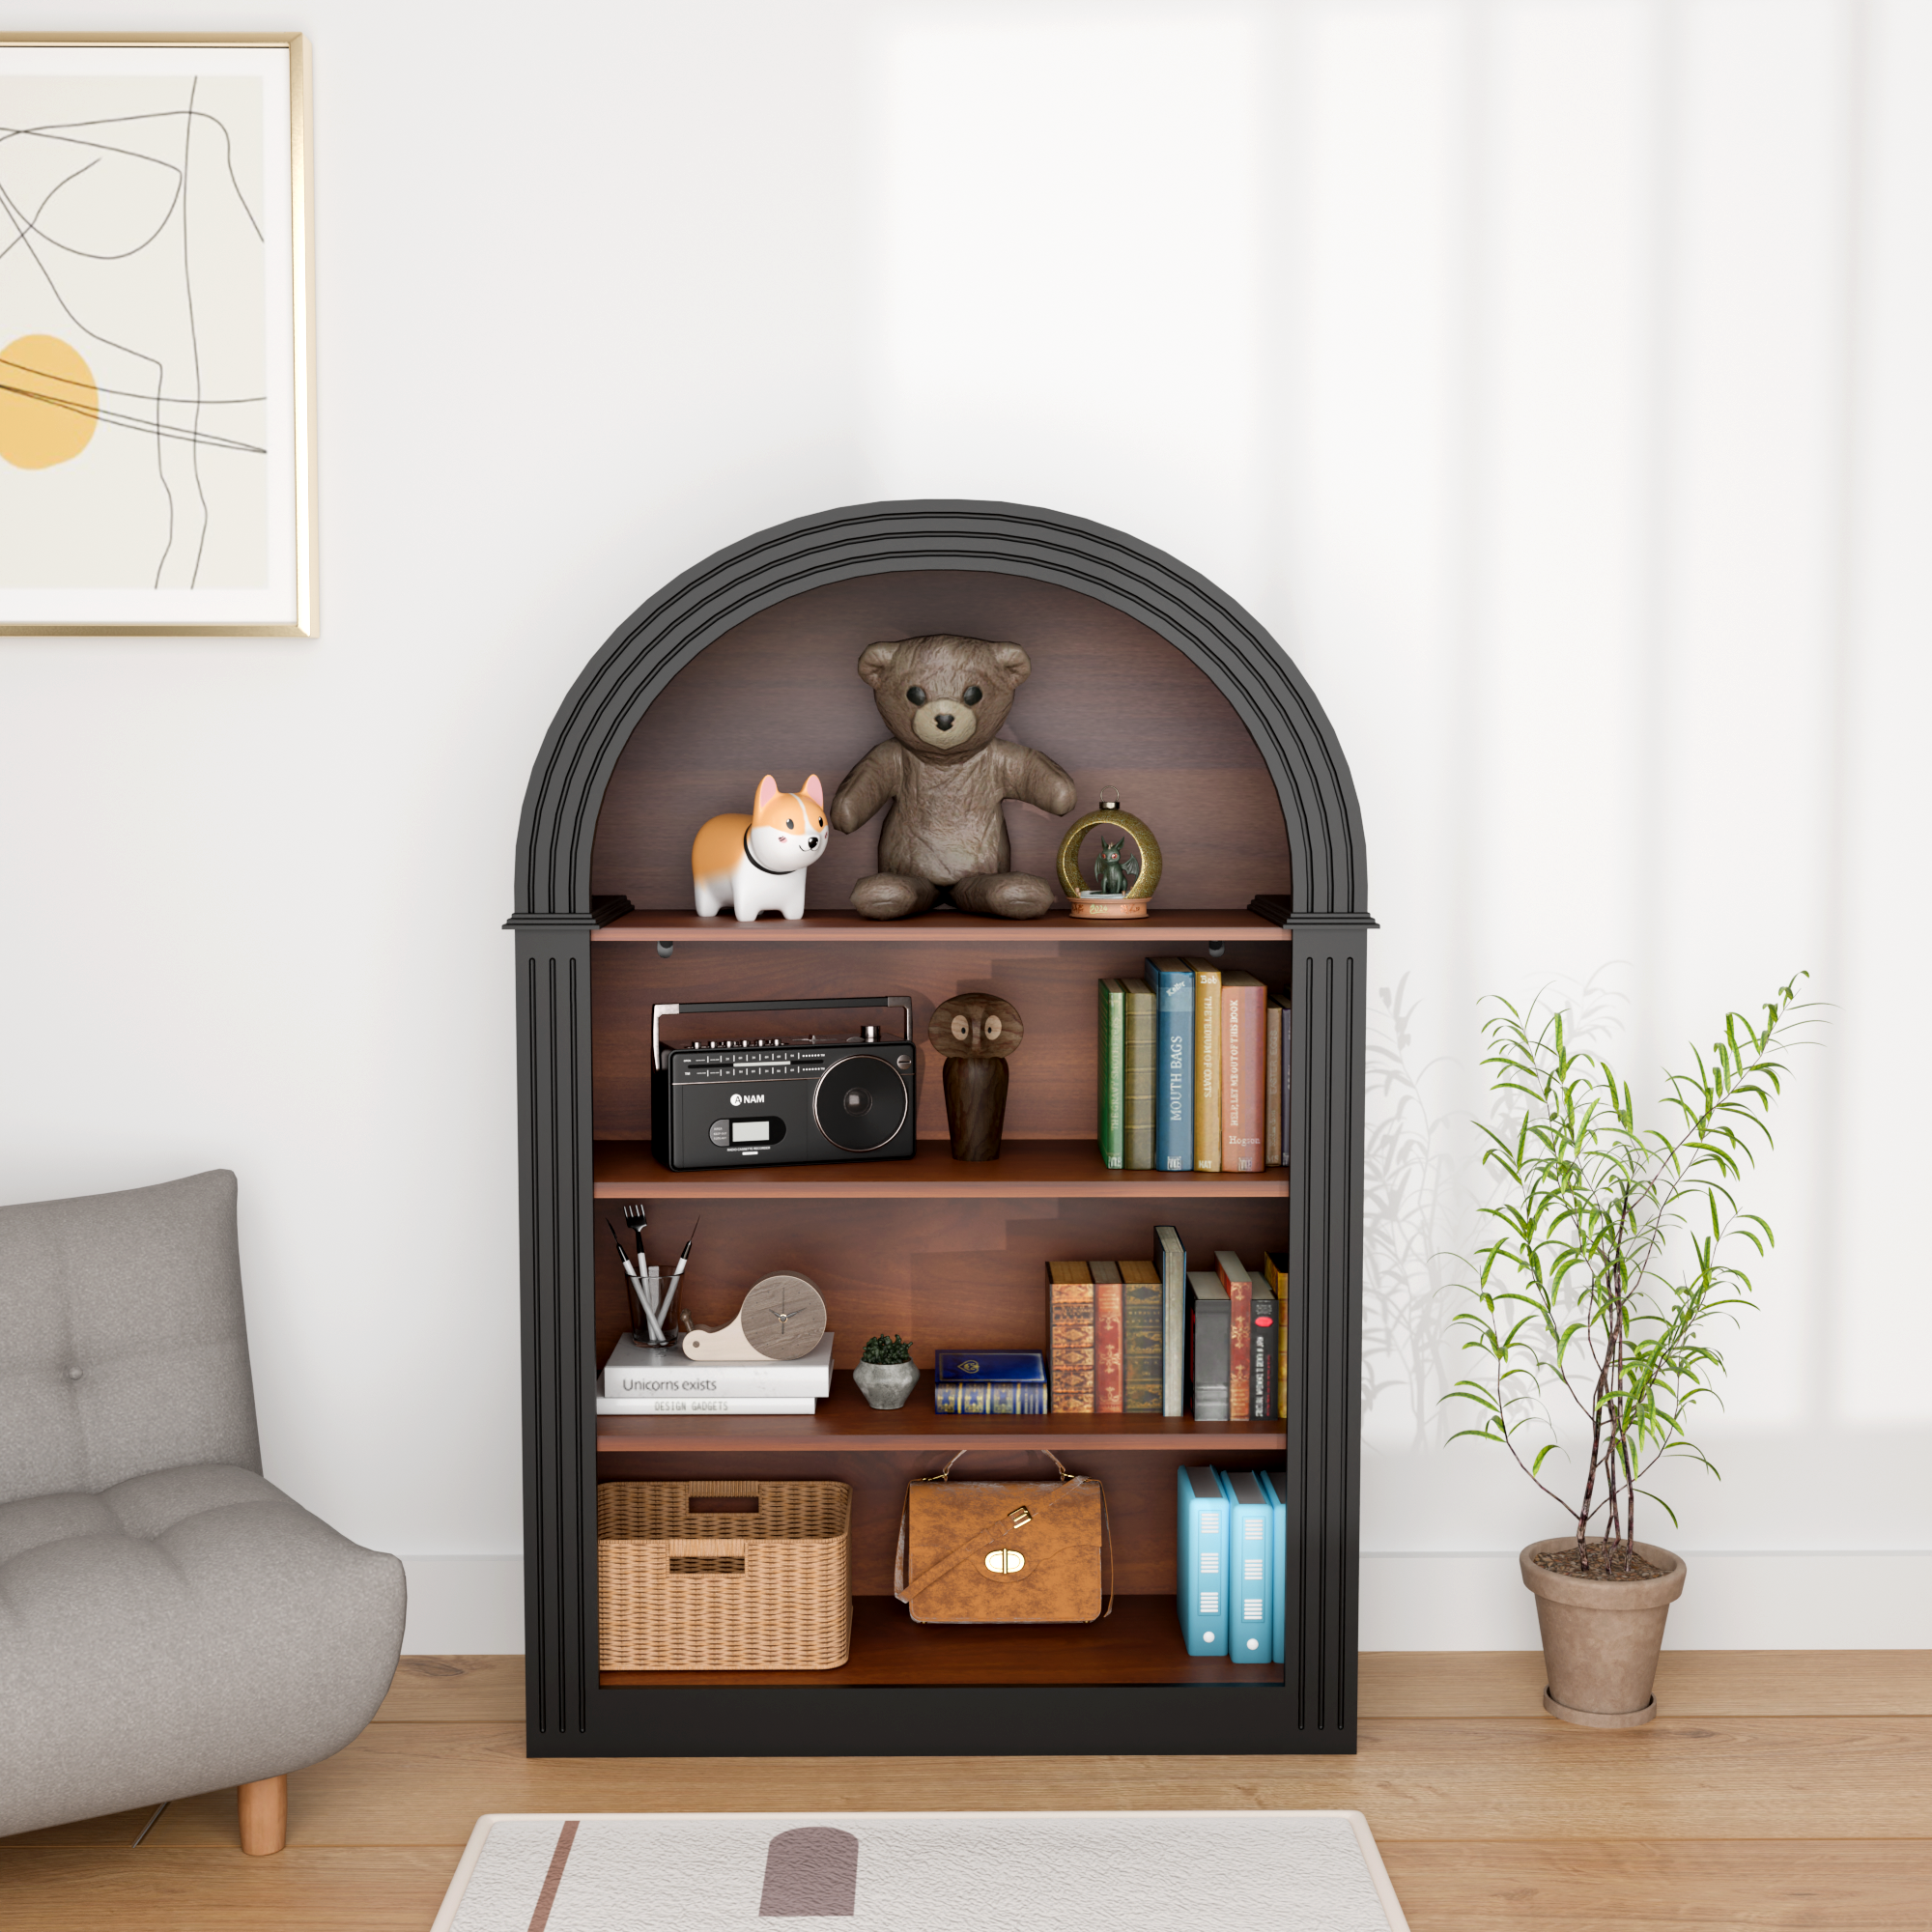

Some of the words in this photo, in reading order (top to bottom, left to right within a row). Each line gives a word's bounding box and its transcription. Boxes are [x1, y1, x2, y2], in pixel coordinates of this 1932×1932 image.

[1200, 975, 1217, 984] Bob
[1204, 996, 1212, 1016] THE
[1269, 1030, 1278, 1056] EGGS
[1171, 1036, 1182, 1069] BAGS
[1231, 1074, 1238, 1087] ME
[1269, 1061, 1278, 1095] EASTER
[743, 1094, 765, 1104] NAM
[1111, 1081, 1120, 1111] GRAVY
[1171, 1071, 1182, 1122] MOUTH
[1230, 1088, 1238, 1103] LET
[623, 1378, 679, 1391] Unicorns
[682, 1378, 717, 1391] exists
[654, 1401, 687, 1411] DESIGN
[691, 1401, 728, 1411] GADGETS
